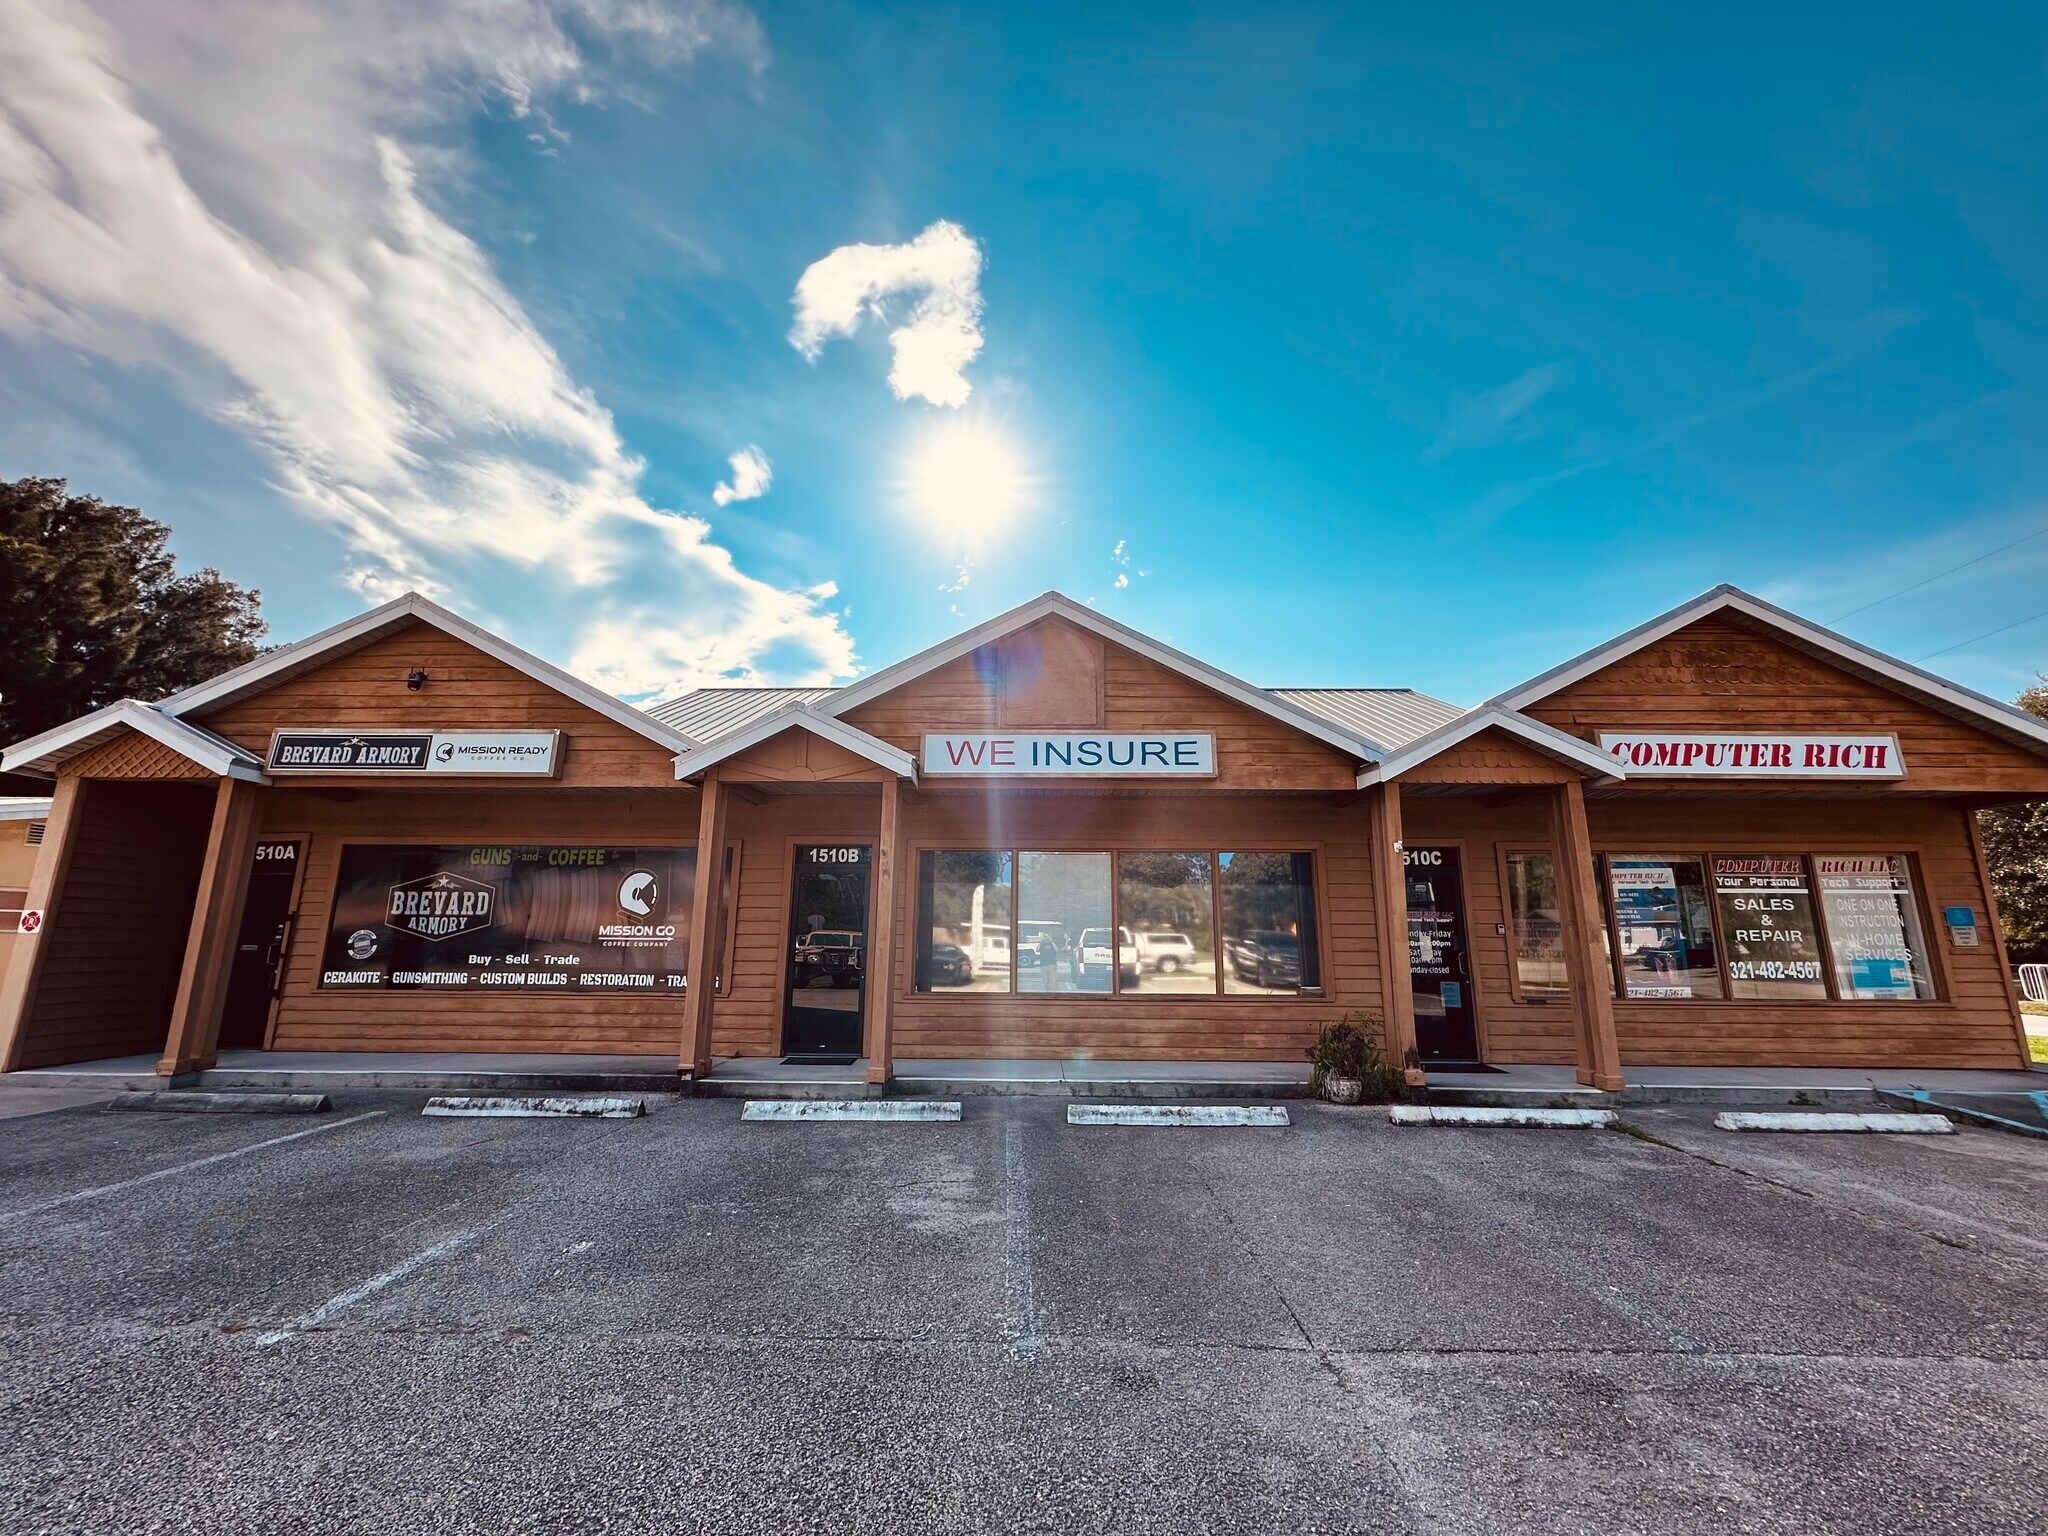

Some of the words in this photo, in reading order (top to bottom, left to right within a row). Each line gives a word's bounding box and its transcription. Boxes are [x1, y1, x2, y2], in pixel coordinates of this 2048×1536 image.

[280, 746, 353, 765] BREVARD
[356, 746, 421, 765] ARMORY
[457, 746, 506, 755] MISSION
[508, 746, 549, 755] READY
[945, 740, 1015, 766] WE
[1032, 740, 1200, 767] INSURE
[1611, 742, 1792, 768] COMPUTER
[1803, 744, 1888, 769] RICH
[470, 848, 512, 866] GUNS
[548, 849, 606, 866] COFFEE
[809, 848, 859, 863] 1510B
[1715, 859, 1799, 874] COMPUTER
[1820, 860, 1863, 873] RICH
[1869, 859, 1899, 875] LLC
[1715, 876, 1744, 887] Your
[1750, 876, 1799, 887] Personal
[1821, 877, 1849, 888] Tech
[1856, 877, 1899, 889] Support
[391, 891, 490, 915] BREVARD
[1733, 898, 1795, 911] SALES
[1836, 898, 1858, 911] ONE
[1861, 898, 1875, 911] ON
[1878, 898, 1899, 911] ONE
[27, 917, 35, 926] R
[407, 915, 468, 934] ARMORY
[1760, 914, 1774, 926] &
[1837, 915, 1905, 928] INSTRUCTION
[598, 925, 653, 937] MISSION
[656, 925, 676, 937] GO
[1736, 930, 1803, 942] REPAIR
[1846, 933, 1904, 946] IN-HOME
[468, 954, 492, 966] Buy
[505, 954, 530, 965] Sell
[544, 954, 580, 965] Trade
[1846, 948, 1912, 961] SERVICES
[1729, 961, 1822, 980] 321-482-4567
[324, 971, 381, 984] CERAKOTE
[392, 972, 468, 984] GUNSMITHING
[480, 973, 525, 985] CUSTOM
[527, 973, 568, 985] BUILDS
[579, 974, 654, 987] RESTORATION
[1628, 988, 1685, 998] 21-482-4567
